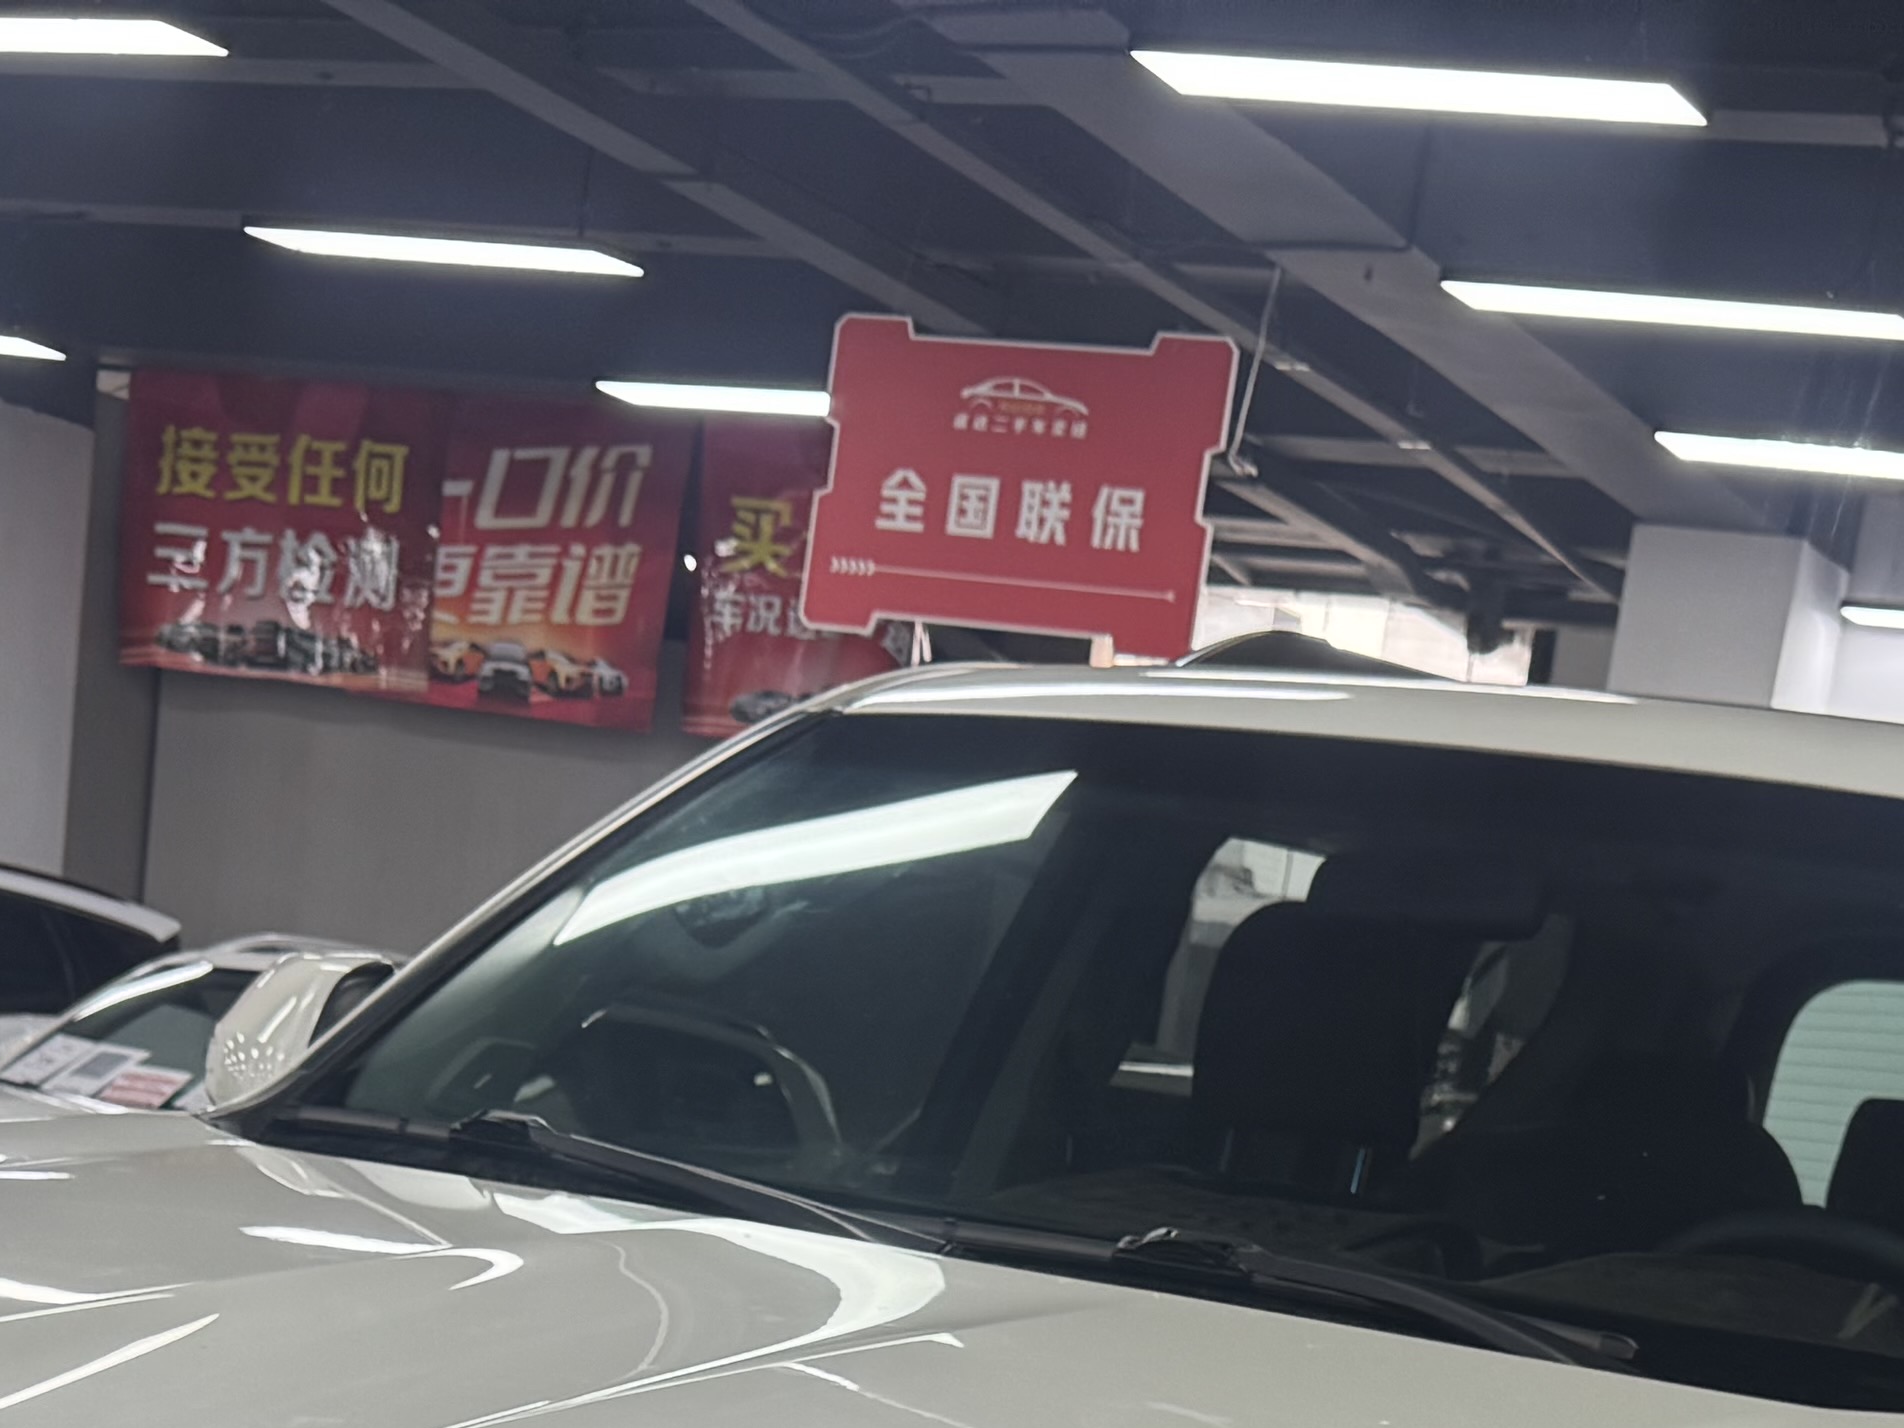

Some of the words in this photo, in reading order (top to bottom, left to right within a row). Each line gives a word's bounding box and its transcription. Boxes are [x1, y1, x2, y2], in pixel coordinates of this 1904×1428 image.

[156, 424, 409, 514] 接受任何
[875, 468, 1146, 552] 全国联保
